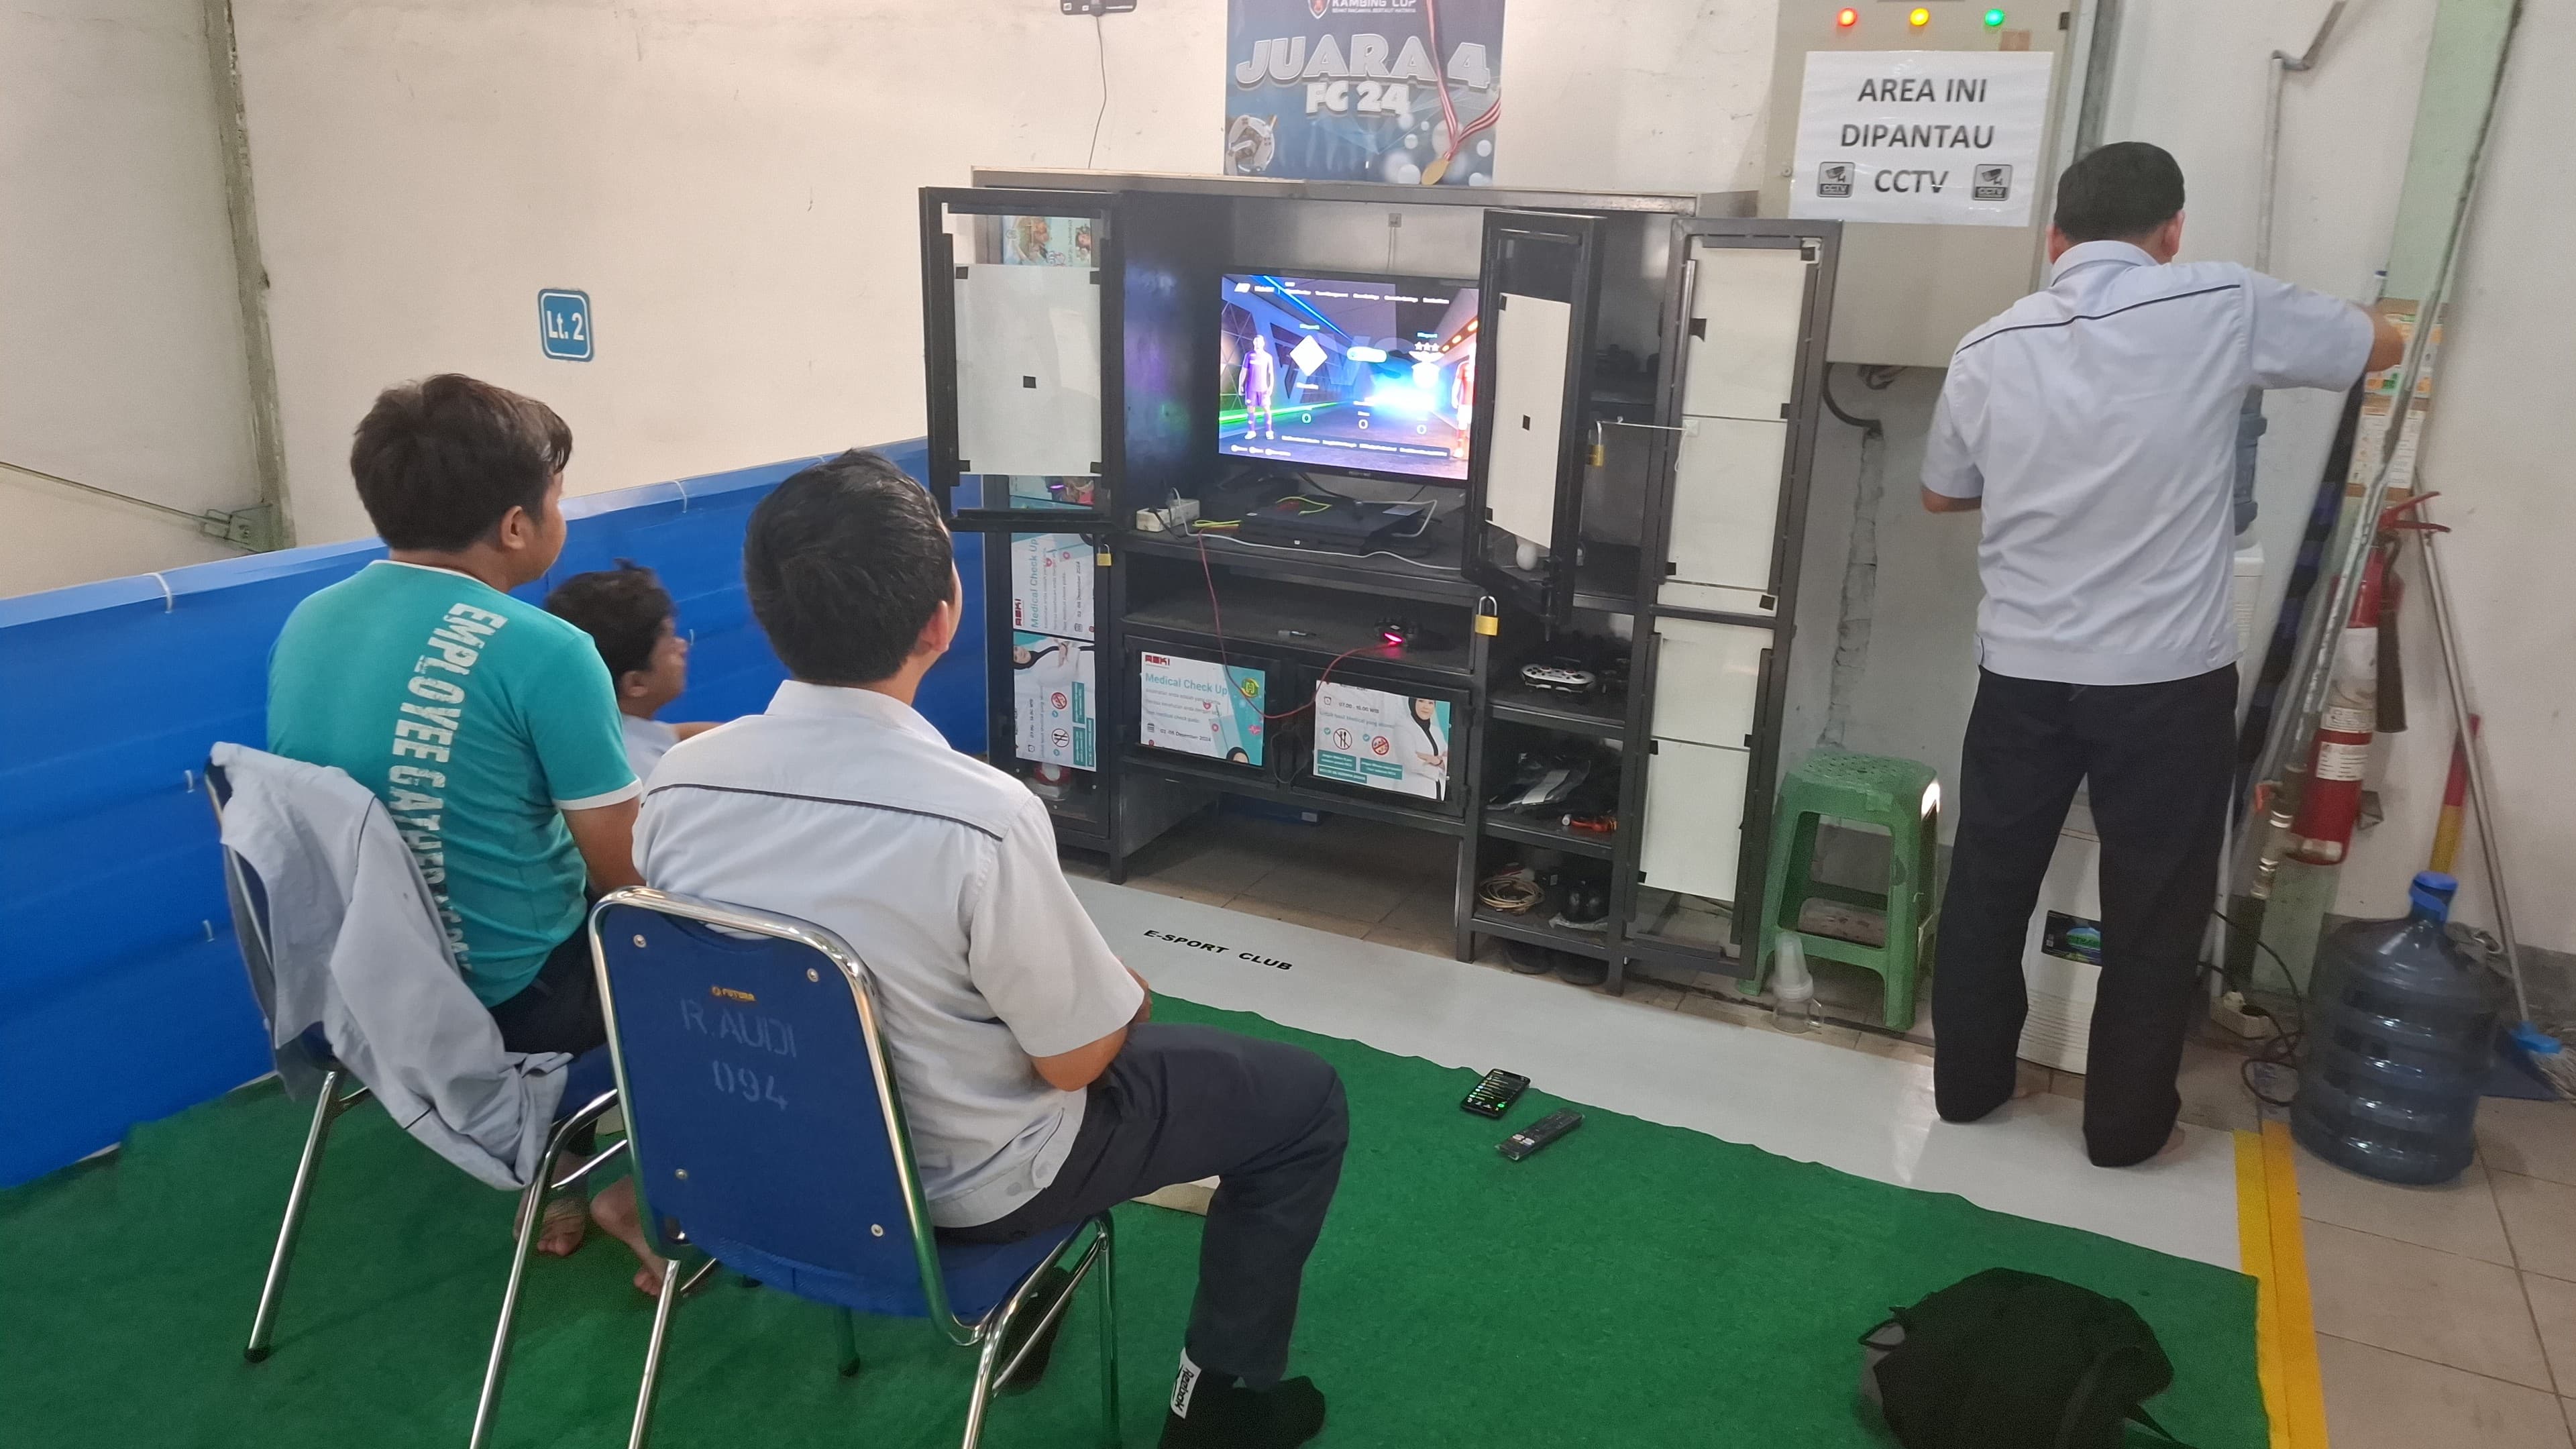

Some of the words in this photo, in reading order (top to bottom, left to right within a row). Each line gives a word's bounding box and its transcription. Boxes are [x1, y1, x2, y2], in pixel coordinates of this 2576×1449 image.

[1236, 34, 1438, 85] JUARA
[1448, 42, 1491, 89] 4
[1306, 80, 1348, 113] FC
[1357, 80, 1410, 114] 24
[1858, 78, 1935, 102] AREA
[1945, 78, 1986, 103] INI
[1841, 124, 1994, 148] DIPANTAU
[1823, 184, 1849, 194] CCTV
[1874, 170, 1948, 193] CCTV
[1980, 187, 2004, 196] CCTV
[547, 310, 569, 339] Lt.
[572, 313, 584, 340] 2
[1029, 539, 1039, 552] Up
[1029, 555, 1038, 586] Check
[1030, 589, 1038, 628] Medical
[392, 602, 508, 763] EMPLOYEE
[1145, 673, 1181, 687] Medical
[1184, 680, 1213, 693] Check
[1215, 685, 1228, 696] Up
[389, 765, 462, 924] GATHE
[1144, 930, 1230, 953] E-SPORT
[1238, 953, 1293, 971] CLUB
[712, 1060, 788, 1111] 094
[1175, 1367, 1194, 1411] Reebok
